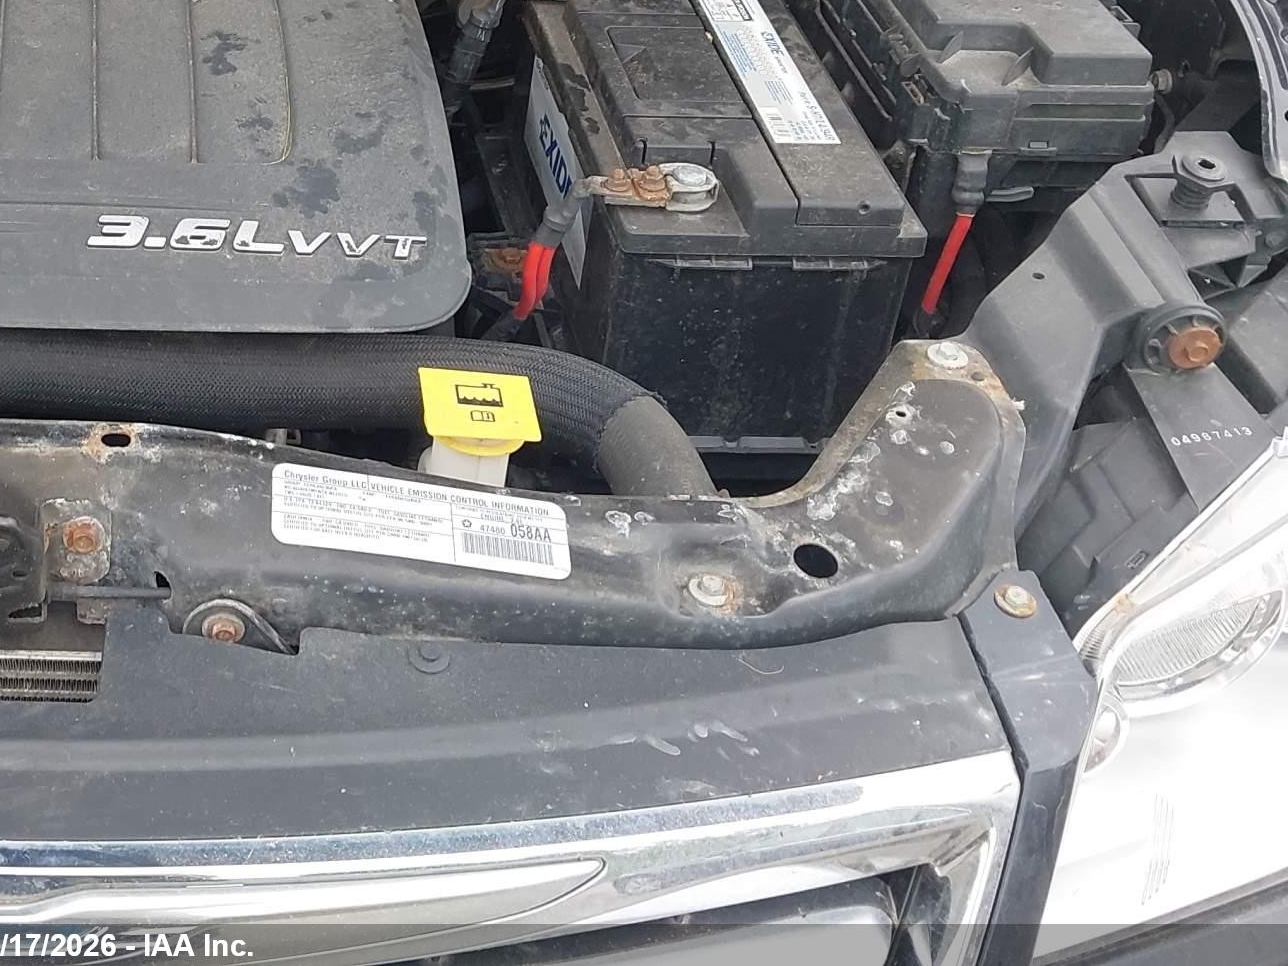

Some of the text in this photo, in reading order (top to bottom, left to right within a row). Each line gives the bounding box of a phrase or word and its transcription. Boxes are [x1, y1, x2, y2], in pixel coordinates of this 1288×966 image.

[87, 214, 427, 259] 3.6L VVT
[284, 470, 319, 482] Chrysler
[322, 476, 348, 488] Group
[351, 480, 367, 488] LLC
[370, 483, 404, 494] VEHICLE
[408, 488, 448, 500] EMISSION
[450, 494, 488, 508] CONTROL
[492, 499, 549, 516] INFORMATION
[510, 524, 552, 543] 058AA
